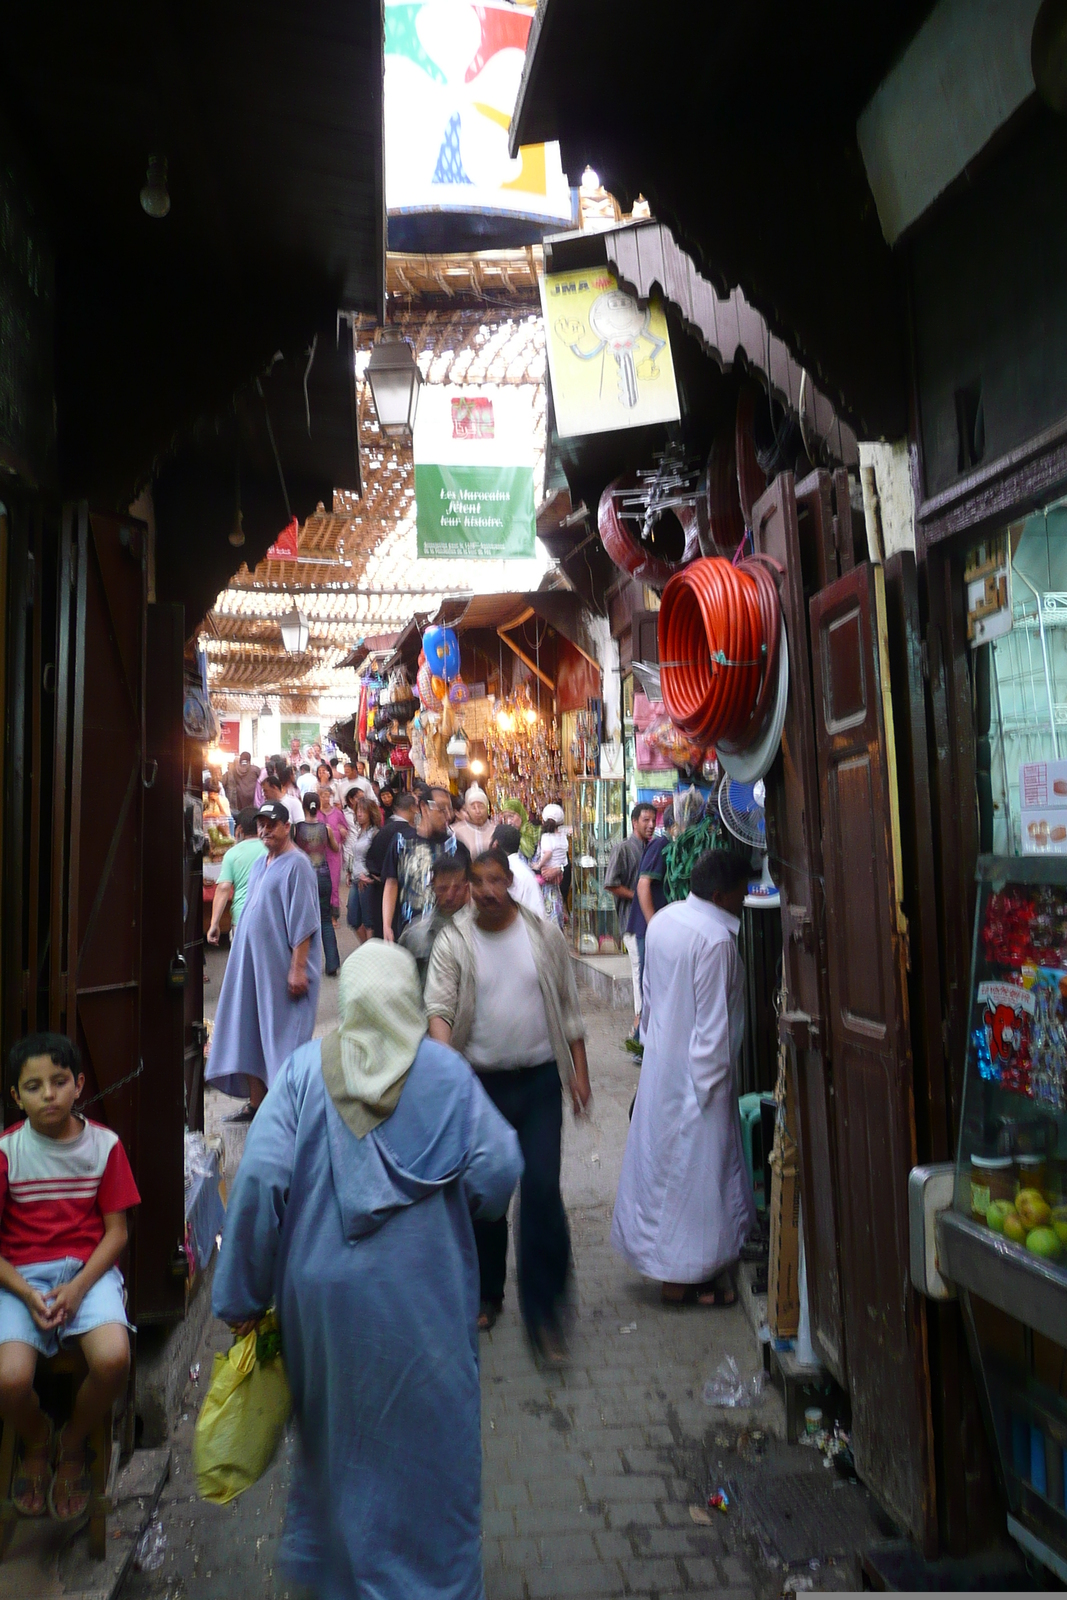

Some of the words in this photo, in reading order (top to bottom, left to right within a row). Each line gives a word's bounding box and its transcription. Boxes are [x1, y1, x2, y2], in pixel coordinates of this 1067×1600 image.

[551, 281, 590, 296] JMA
[440, 488, 457, 500] Les
[458, 489, 511, 501] Marocains
[440, 515, 461, 526] leur
